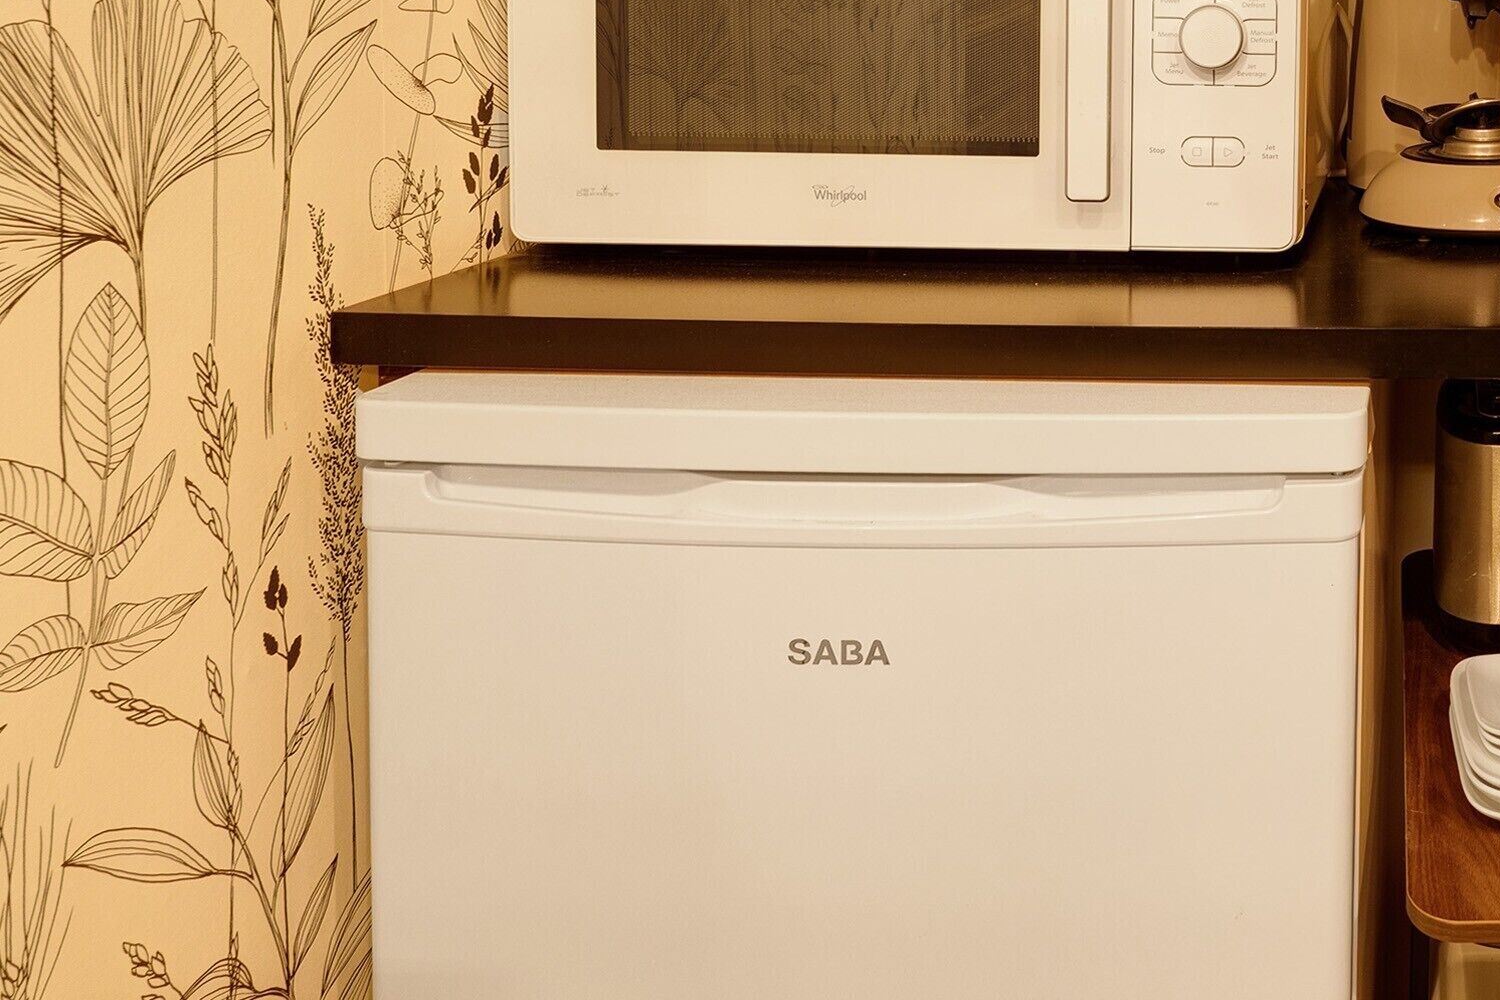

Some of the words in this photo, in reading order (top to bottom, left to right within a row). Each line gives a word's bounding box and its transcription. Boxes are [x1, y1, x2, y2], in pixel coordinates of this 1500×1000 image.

[1148, 146, 1166, 154] Stop
[812, 188, 867, 203] Whirlpool
[787, 638, 891, 666] SABA
